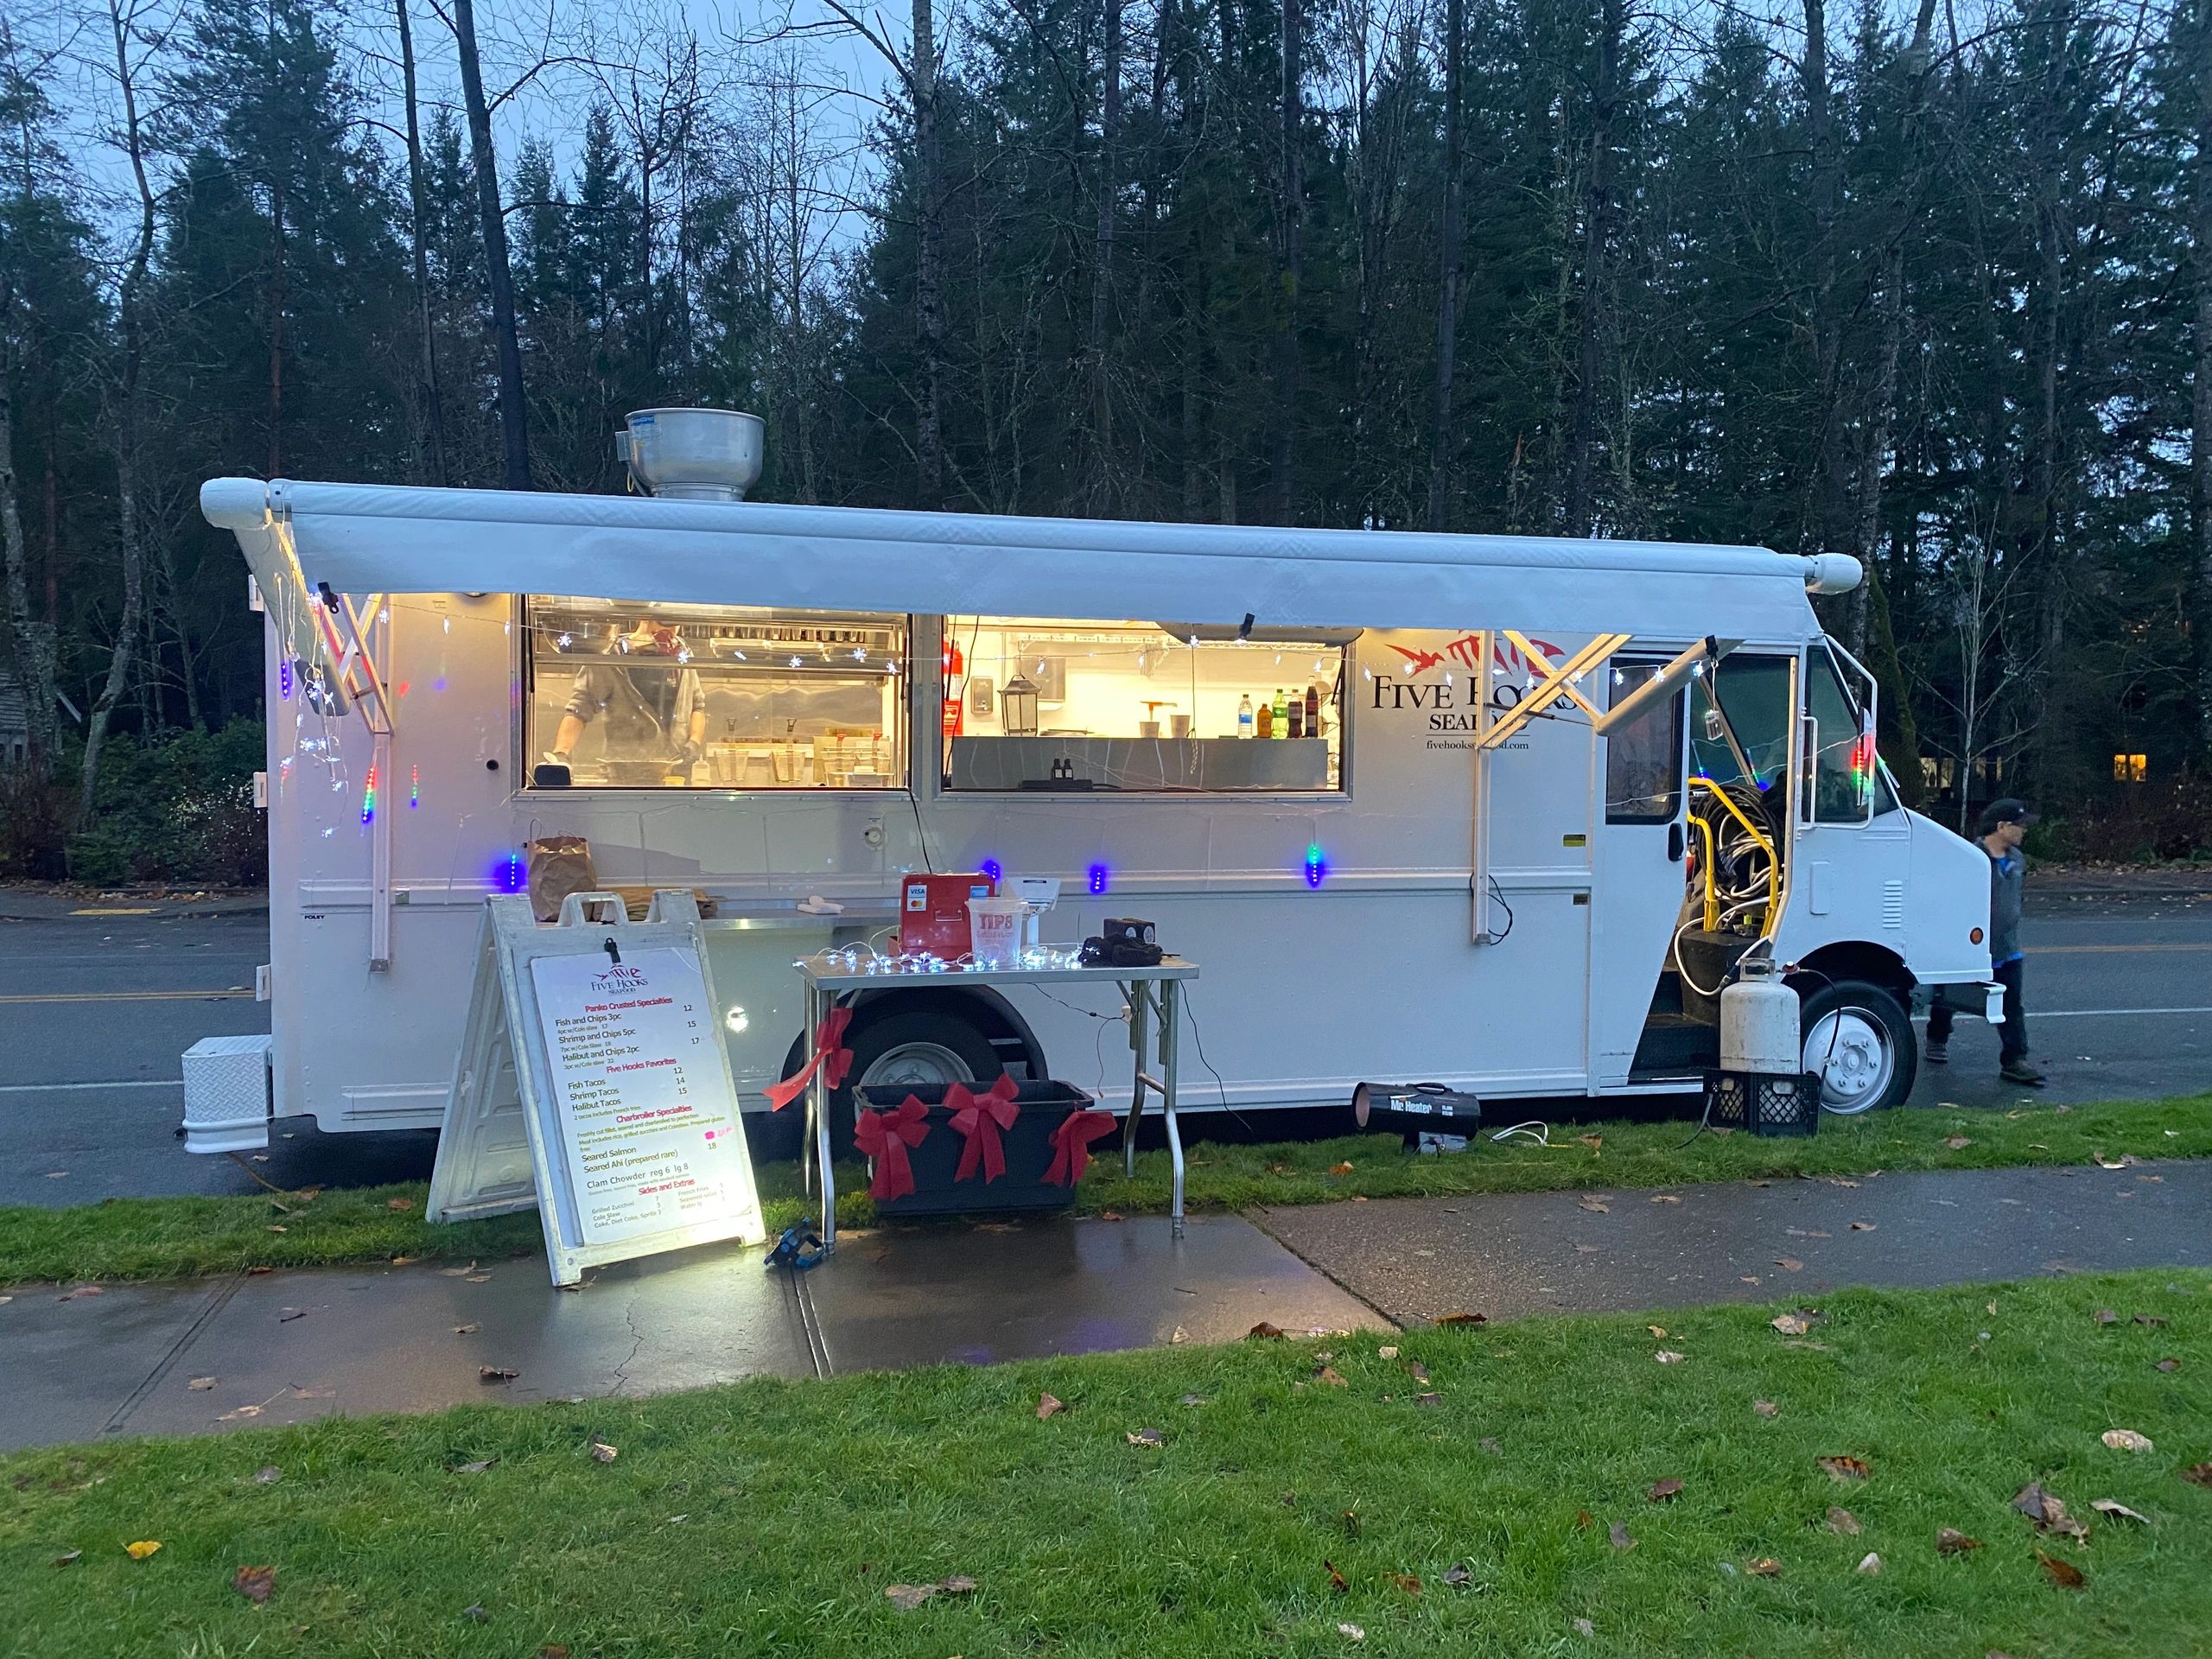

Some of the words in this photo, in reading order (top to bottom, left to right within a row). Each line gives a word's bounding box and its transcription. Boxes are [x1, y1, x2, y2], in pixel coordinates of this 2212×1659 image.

[1371, 675, 1454, 709] FIVE
[978, 913, 1013, 930] TIPS
[591, 982, 613, 991] FIVE
[617, 978, 649, 989] HOOKS
[585, 1003, 608, 1013] Panko
[609, 1000, 636, 1009] Crusted
[637, 996, 673, 1007] Specialties
[588, 1014, 607, 1024] Chips
[608, 1014, 622, 1022] 3pc
[559, 1034, 586, 1044] Shrimp
[602, 1030, 622, 1039] Chips
[622, 1028, 636, 1037] 5pc
[563, 1053, 589, 1062] Halibut
[606, 1048, 626, 1057] Chips
[626, 1046, 639, 1054] 2pc
[645, 1058, 677, 1068] Favorites
[584, 1078, 606, 1087] Tacos
[570, 1091, 597, 1101] Shrimp
[598, 1088, 620, 1096] Tacos
[572, 1102, 600, 1111] Halibut
[657, 1104, 692, 1117] Specialties
[1405, 1100, 1433, 1115] Heater
[582, 1151, 608, 1162] Seared
[609, 1147, 637, 1158] Salmon
[583, 1162, 610, 1173] Seared
[611, 1160, 624, 1168] Ahi
[625, 1154, 659, 1167] (prepared
[661, 1149, 678, 1159] rare)
[708, 1141, 716, 1150] 18
[588, 1179, 608, 1189] Clam
[610, 1172, 646, 1184] Chowder
[650, 1168, 664, 1177] reg
[674, 1164, 682, 1173] lg
[639, 1185, 658, 1196] Sides
[659, 1182, 672, 1191] and
[674, 1179, 696, 1188] Extras
[592, 1205, 611, 1215] Grilled
[612, 1200, 635, 1211] Zucchini
